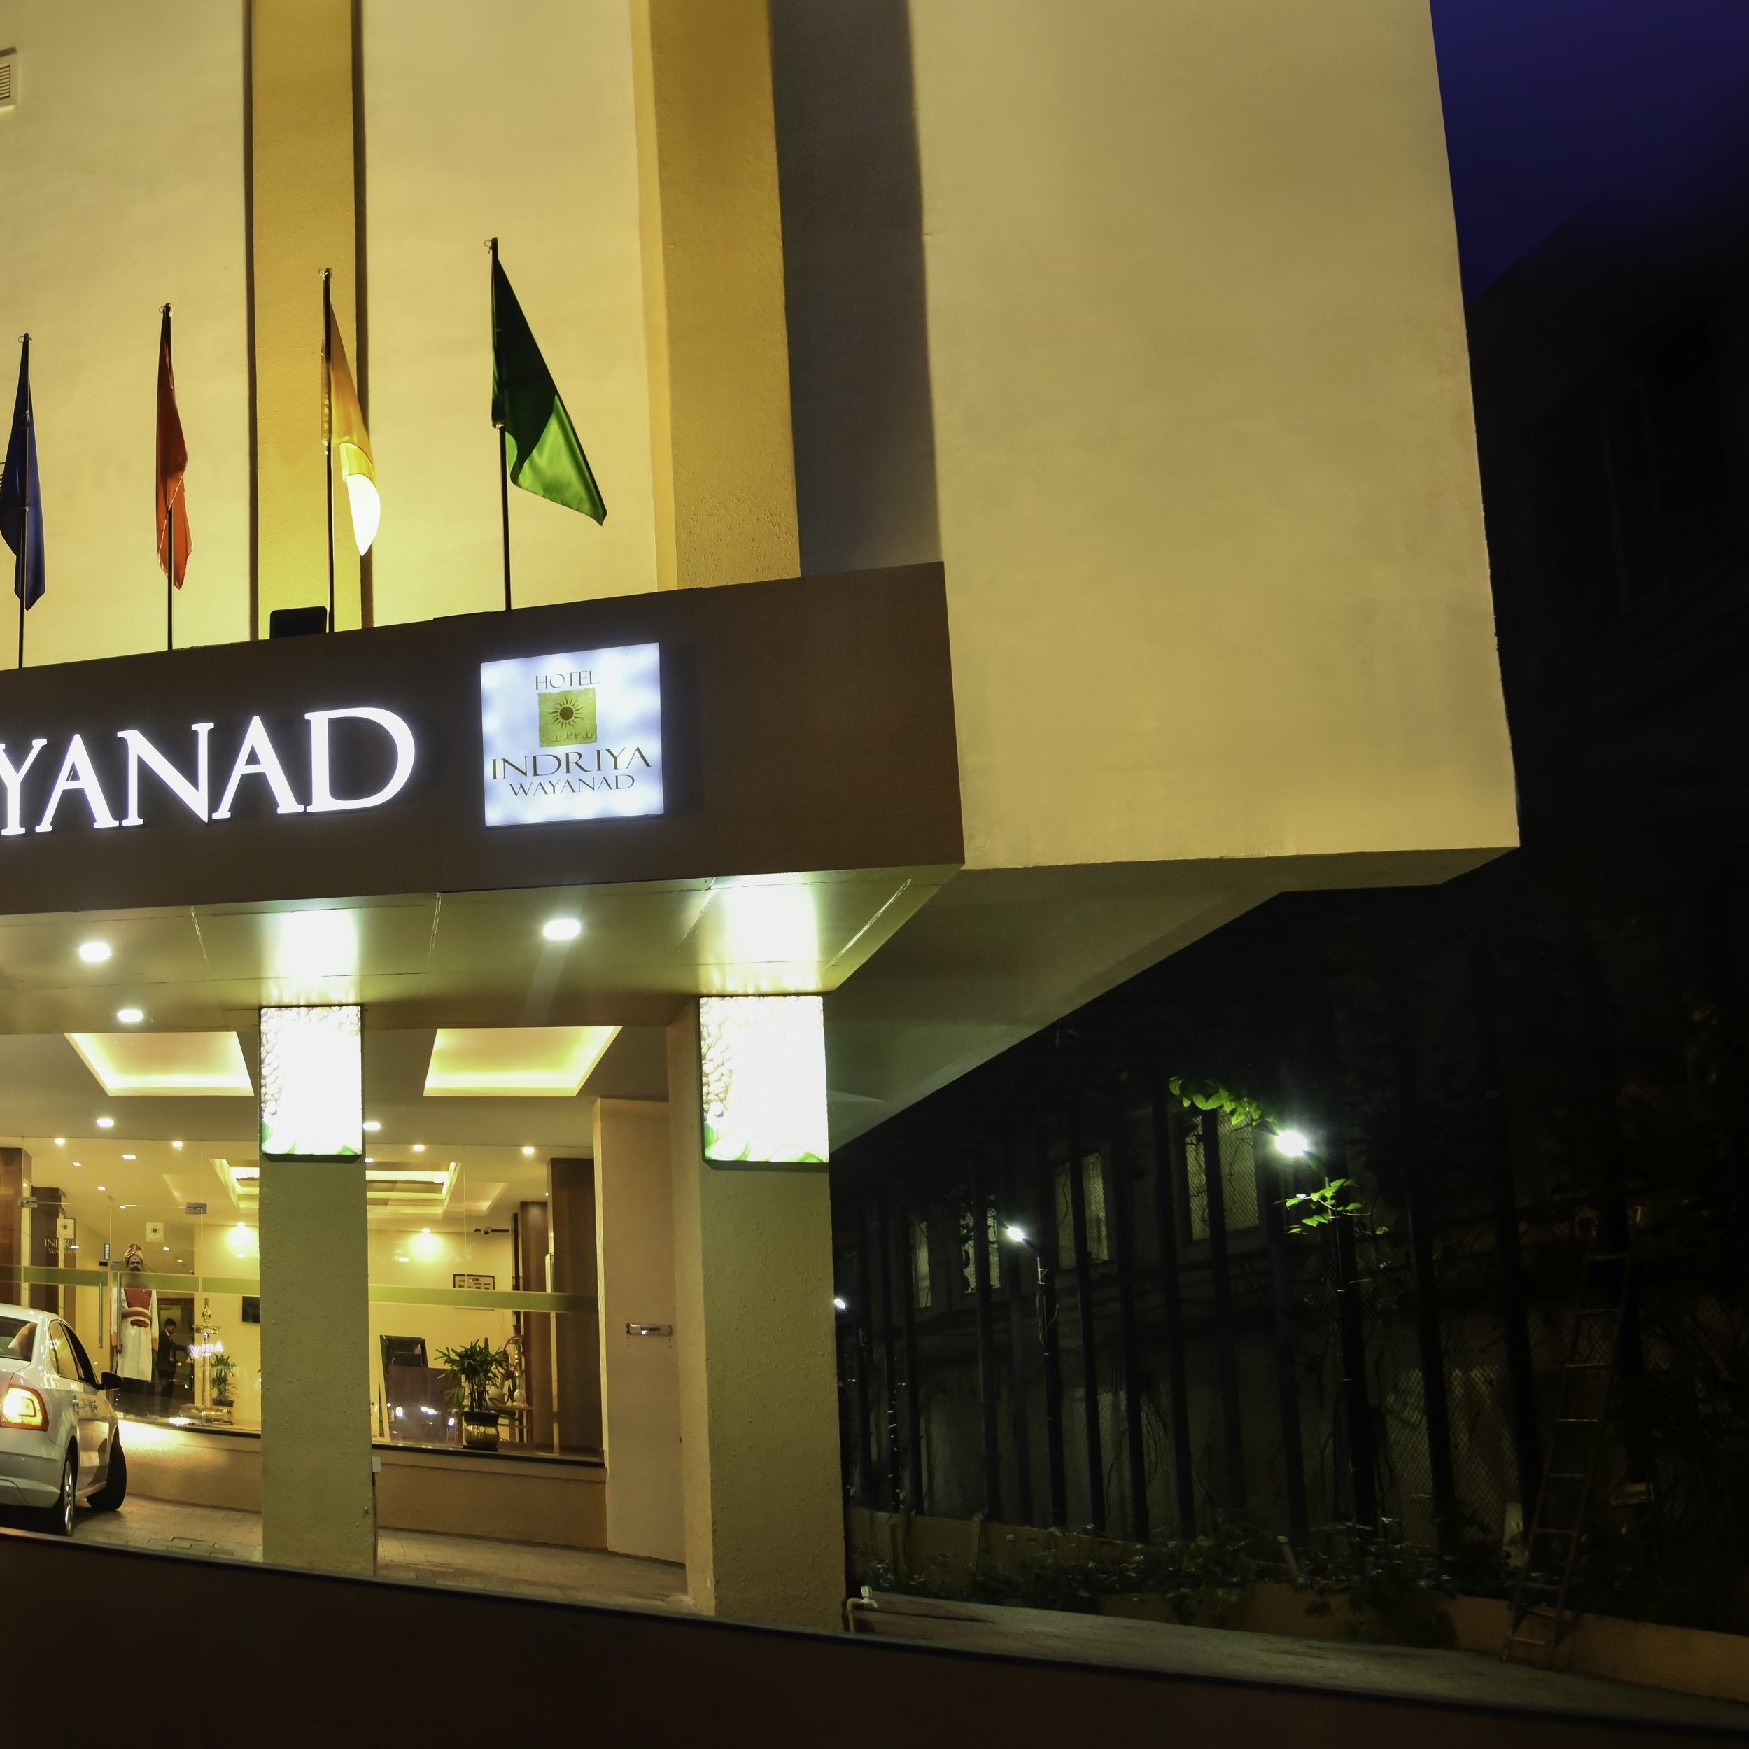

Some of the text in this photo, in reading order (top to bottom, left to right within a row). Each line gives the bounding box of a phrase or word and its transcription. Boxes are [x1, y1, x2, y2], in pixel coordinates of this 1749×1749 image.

[535, 670, 599, 690] HOTEL
[492, 746, 652, 780] INDRIYA
[509, 773, 635, 797] WAYANAD
